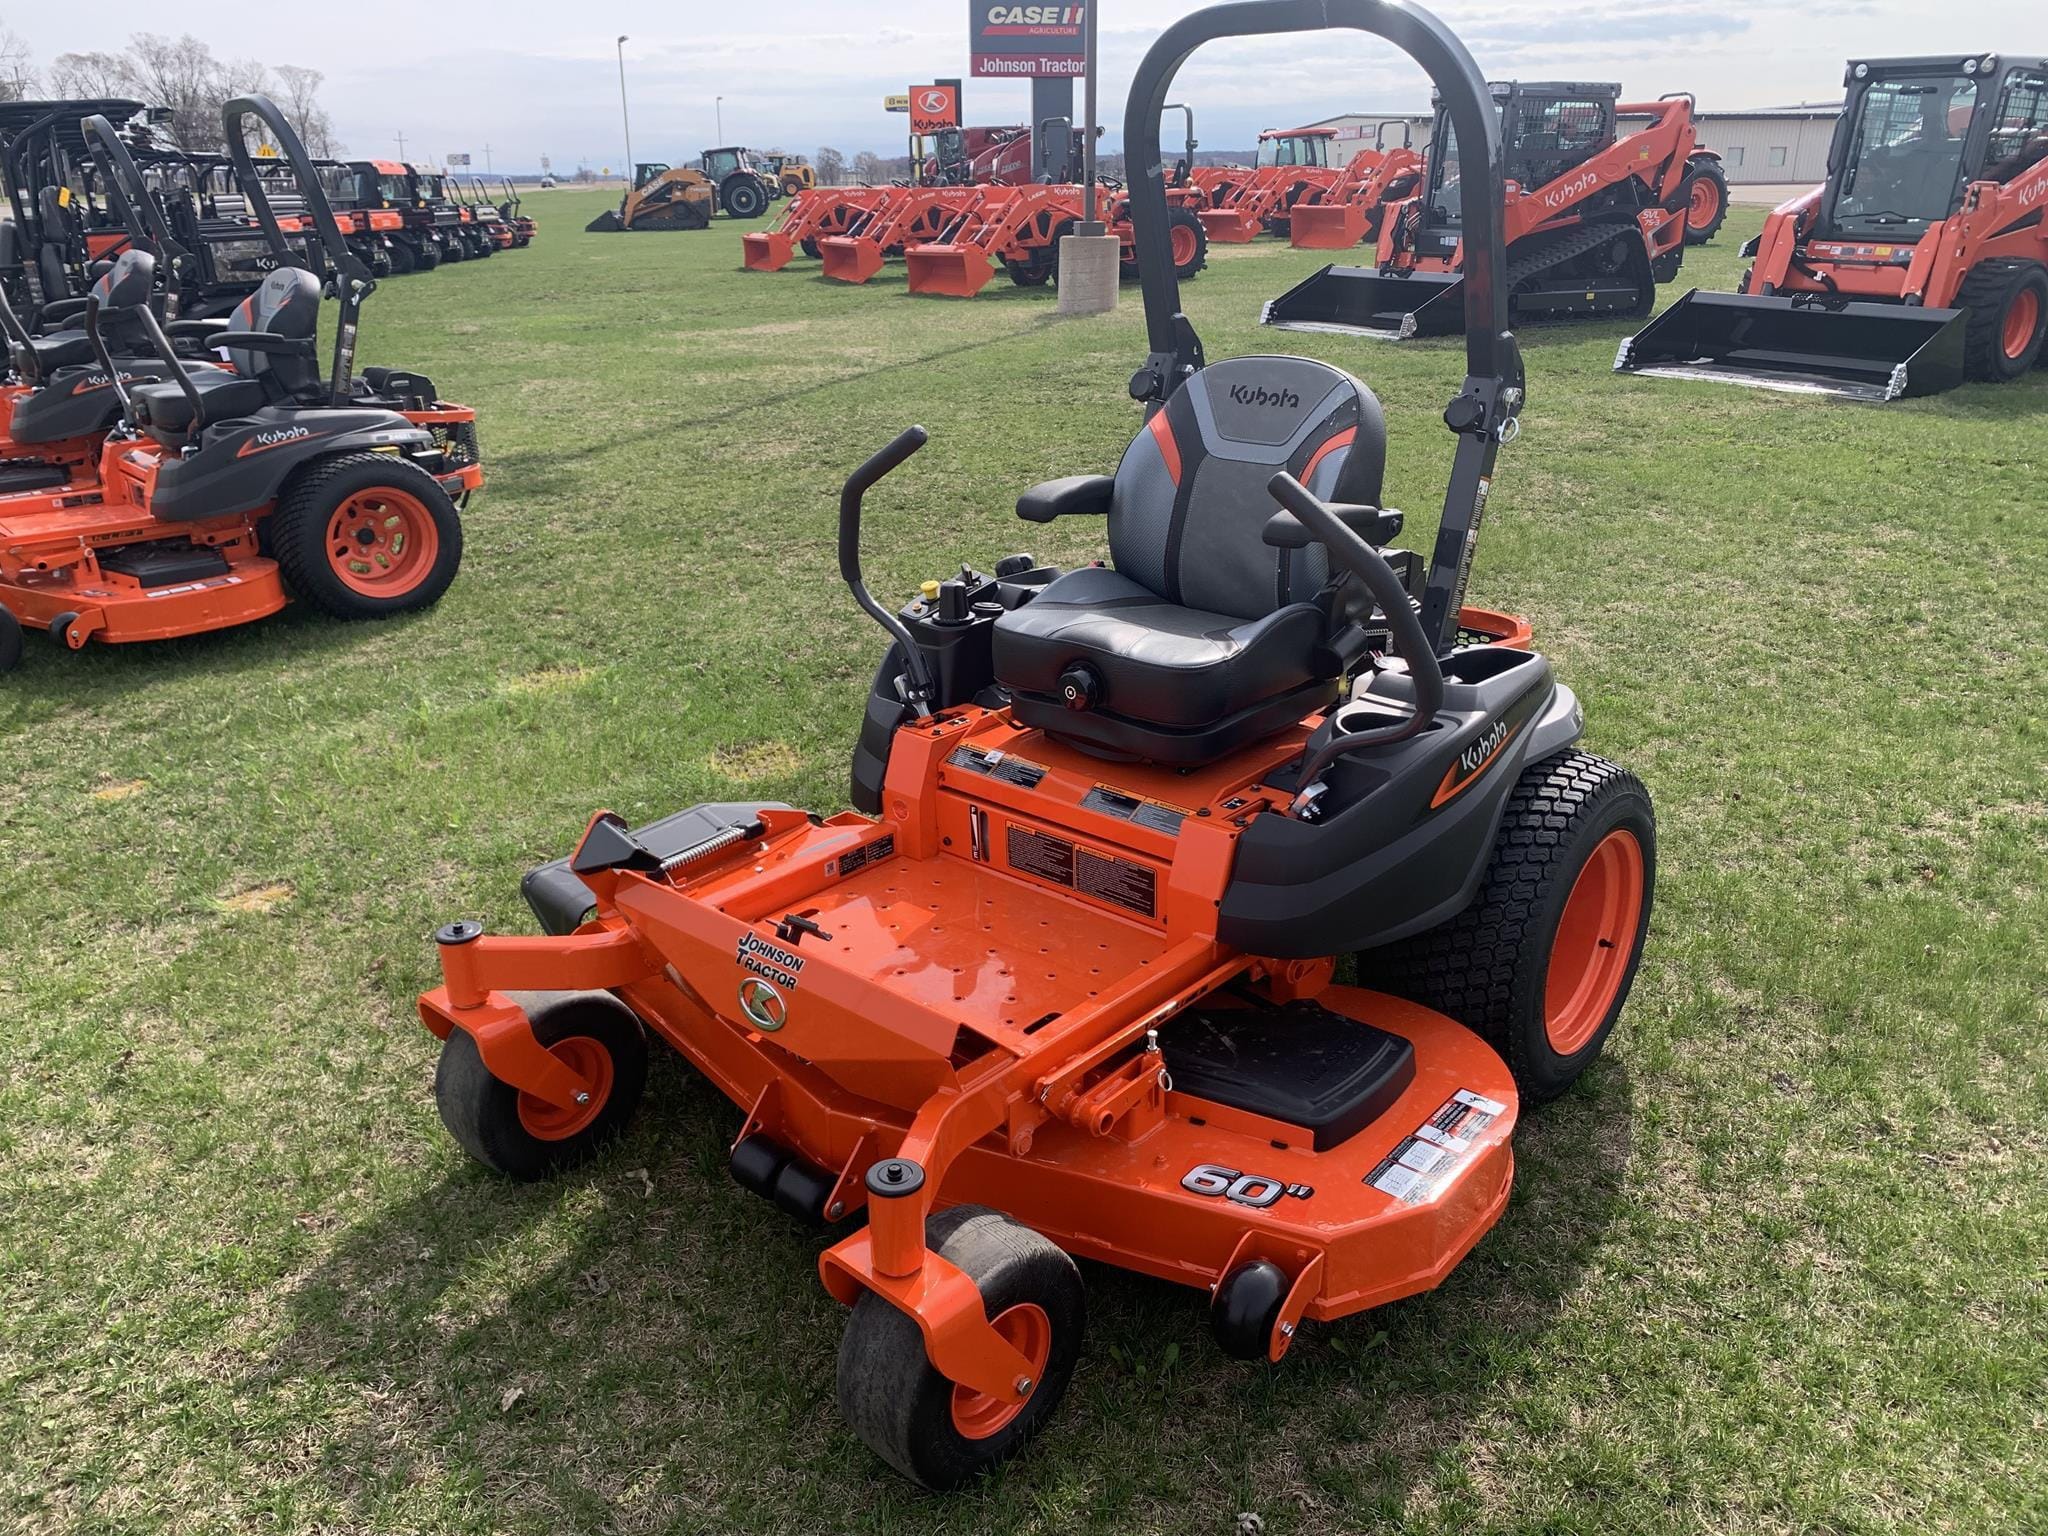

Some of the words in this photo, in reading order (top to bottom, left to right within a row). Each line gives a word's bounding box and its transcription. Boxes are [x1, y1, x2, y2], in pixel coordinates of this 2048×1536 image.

[987, 6, 1060, 24] CASE
[1028, 27, 1077, 35] AGRICULTURE
[980, 58, 1036, 73] Johnson
[1039, 58, 1085, 73] Tractor
[913, 118, 954, 130] Kubota
[1053, 187, 1080, 196] Kubota
[1545, 172, 1598, 208] Kubota
[2018, 176, 2048, 206] Kub
[1642, 210, 1661, 219] SVL
[87, 371, 132, 385] Kuta
[1229, 384, 1300, 409] Kubota
[257, 426, 309, 444] Kubota
[1461, 720, 1507, 771] Kubota
[738, 931, 804, 972] JOHNSON
[736, 948, 797, 990] TRACTOR
[1181, 1164, 1315, 1208] 60"
